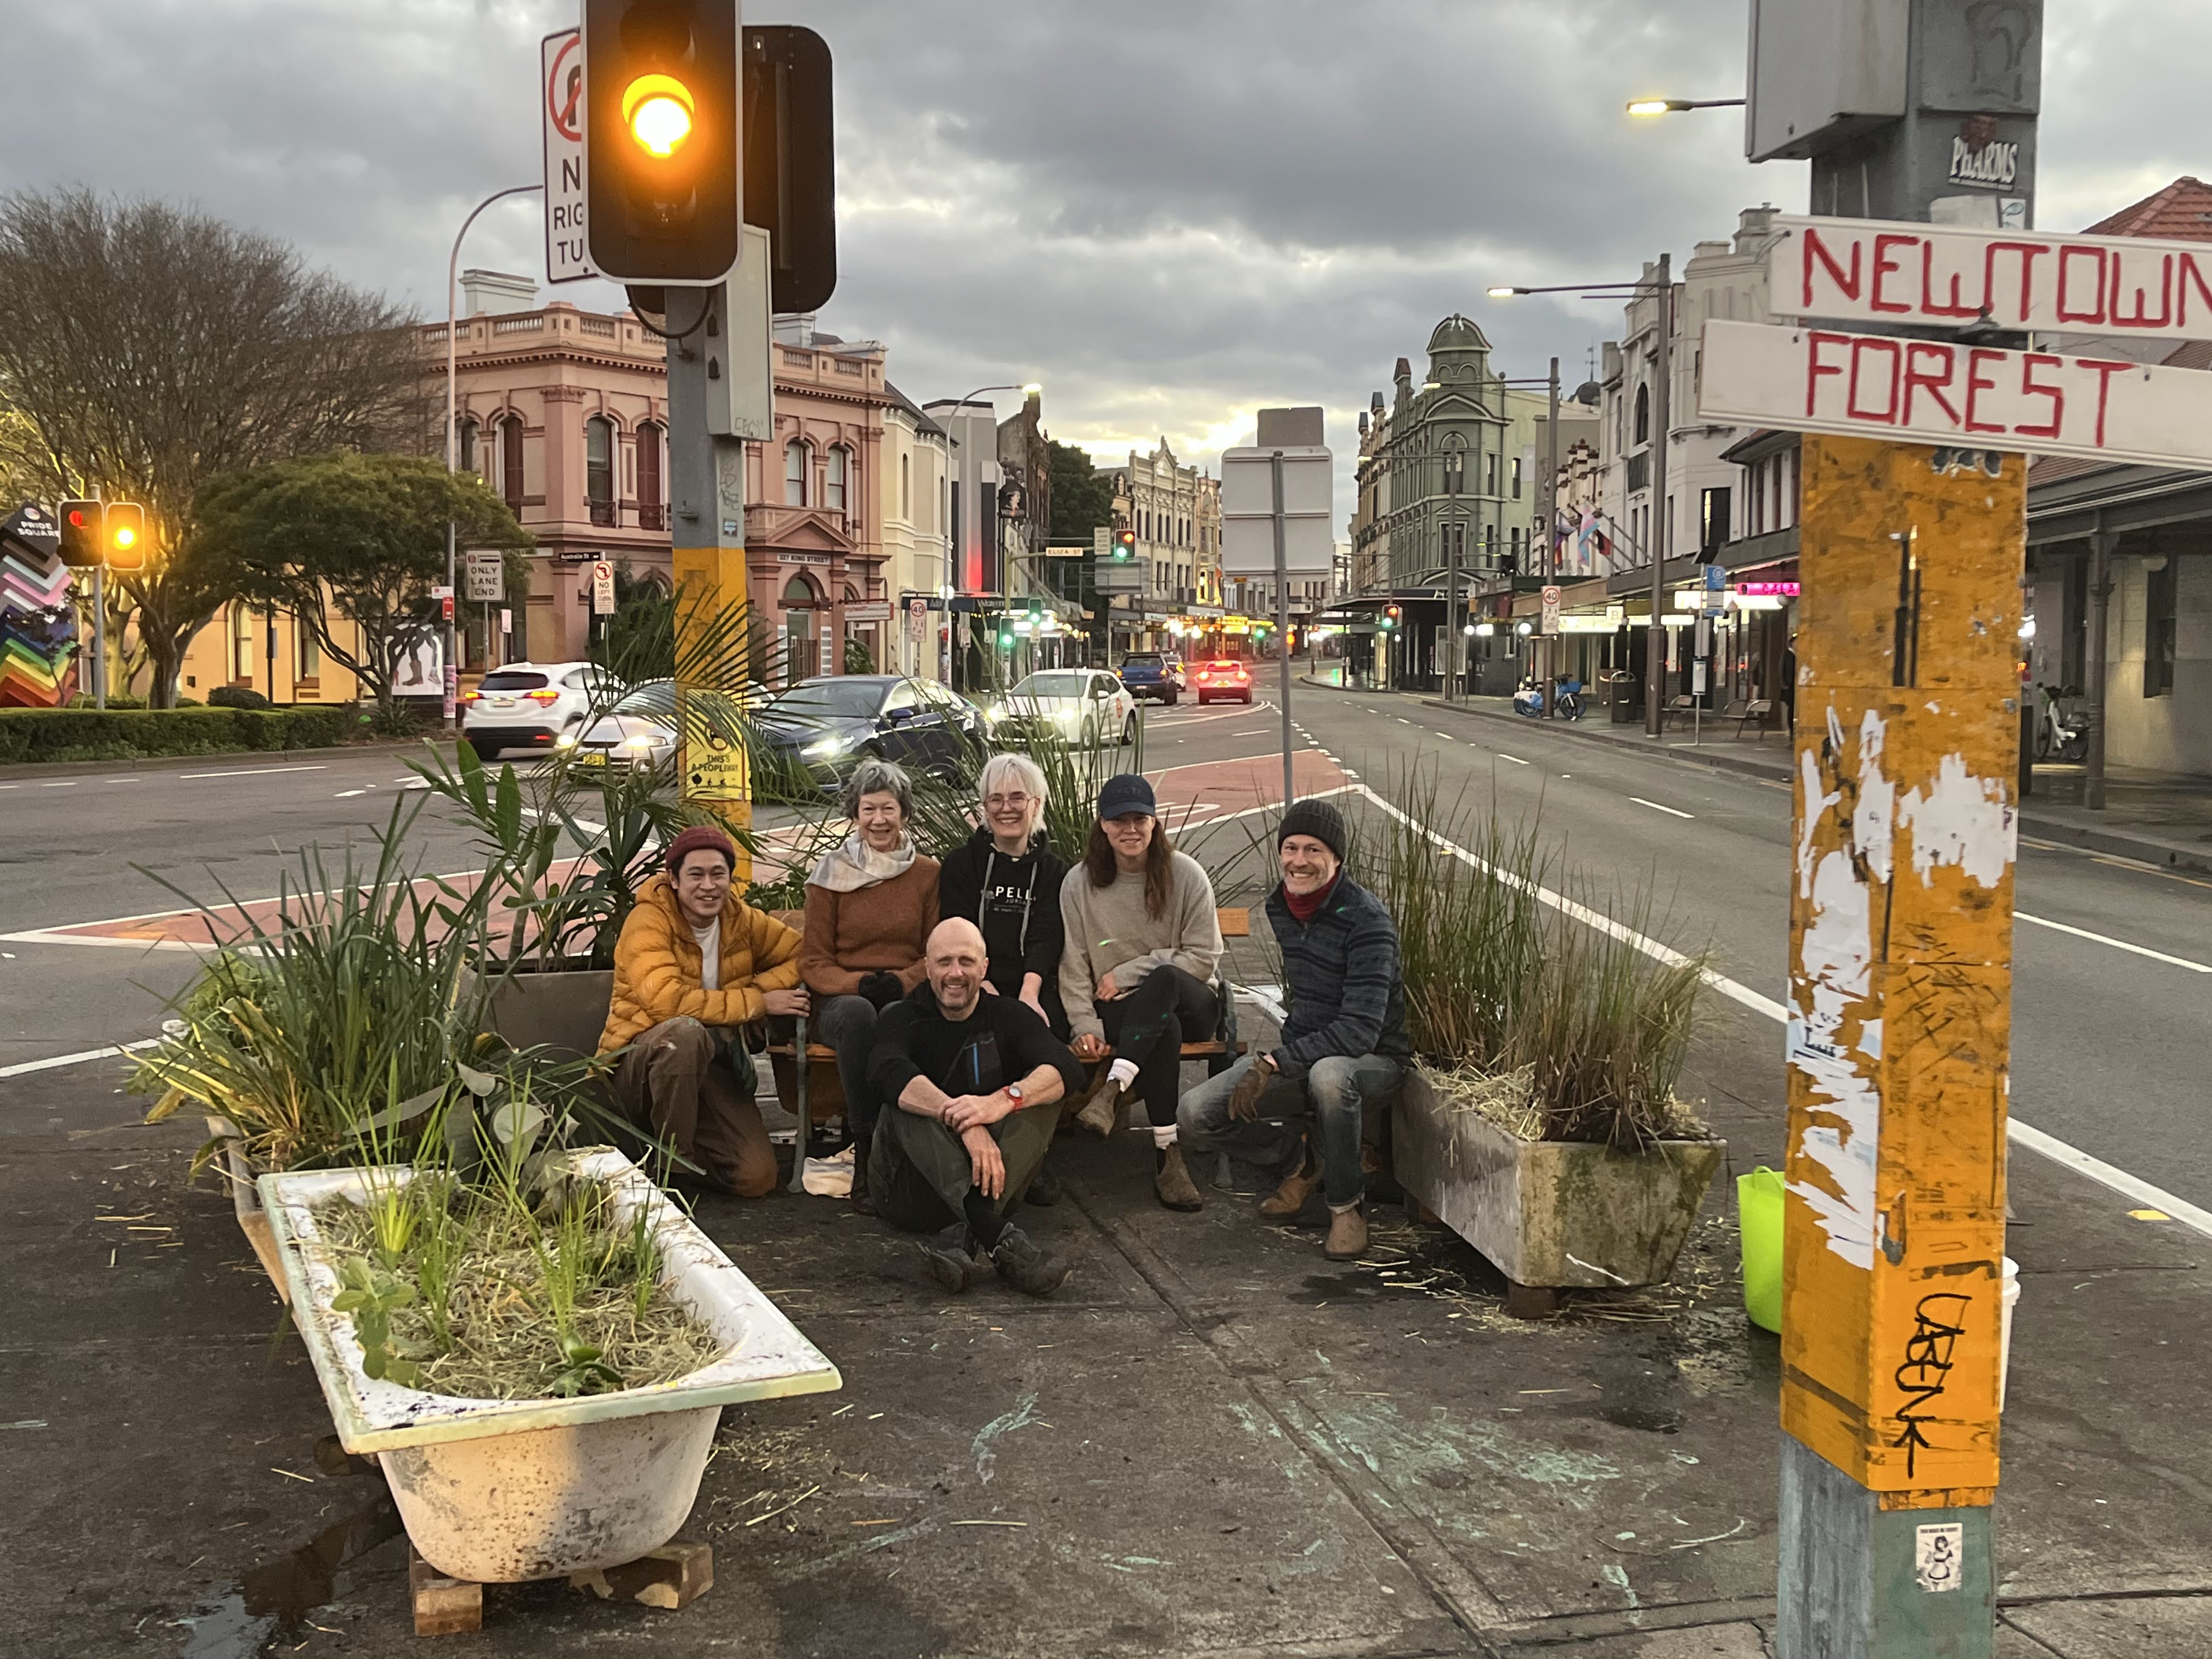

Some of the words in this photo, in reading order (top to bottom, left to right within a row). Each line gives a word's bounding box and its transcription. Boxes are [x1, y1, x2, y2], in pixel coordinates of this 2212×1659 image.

[562, 155, 581, 194] N
[554, 201, 583, 230] RIG
[557, 238, 583, 264] TU
[1803, 227, 2212, 328] NEWTOWN
[1807, 331, 2138, 447] FOREST
[21, 521, 53, 530] PRIDE
[995, 885, 1036, 901] PELL
